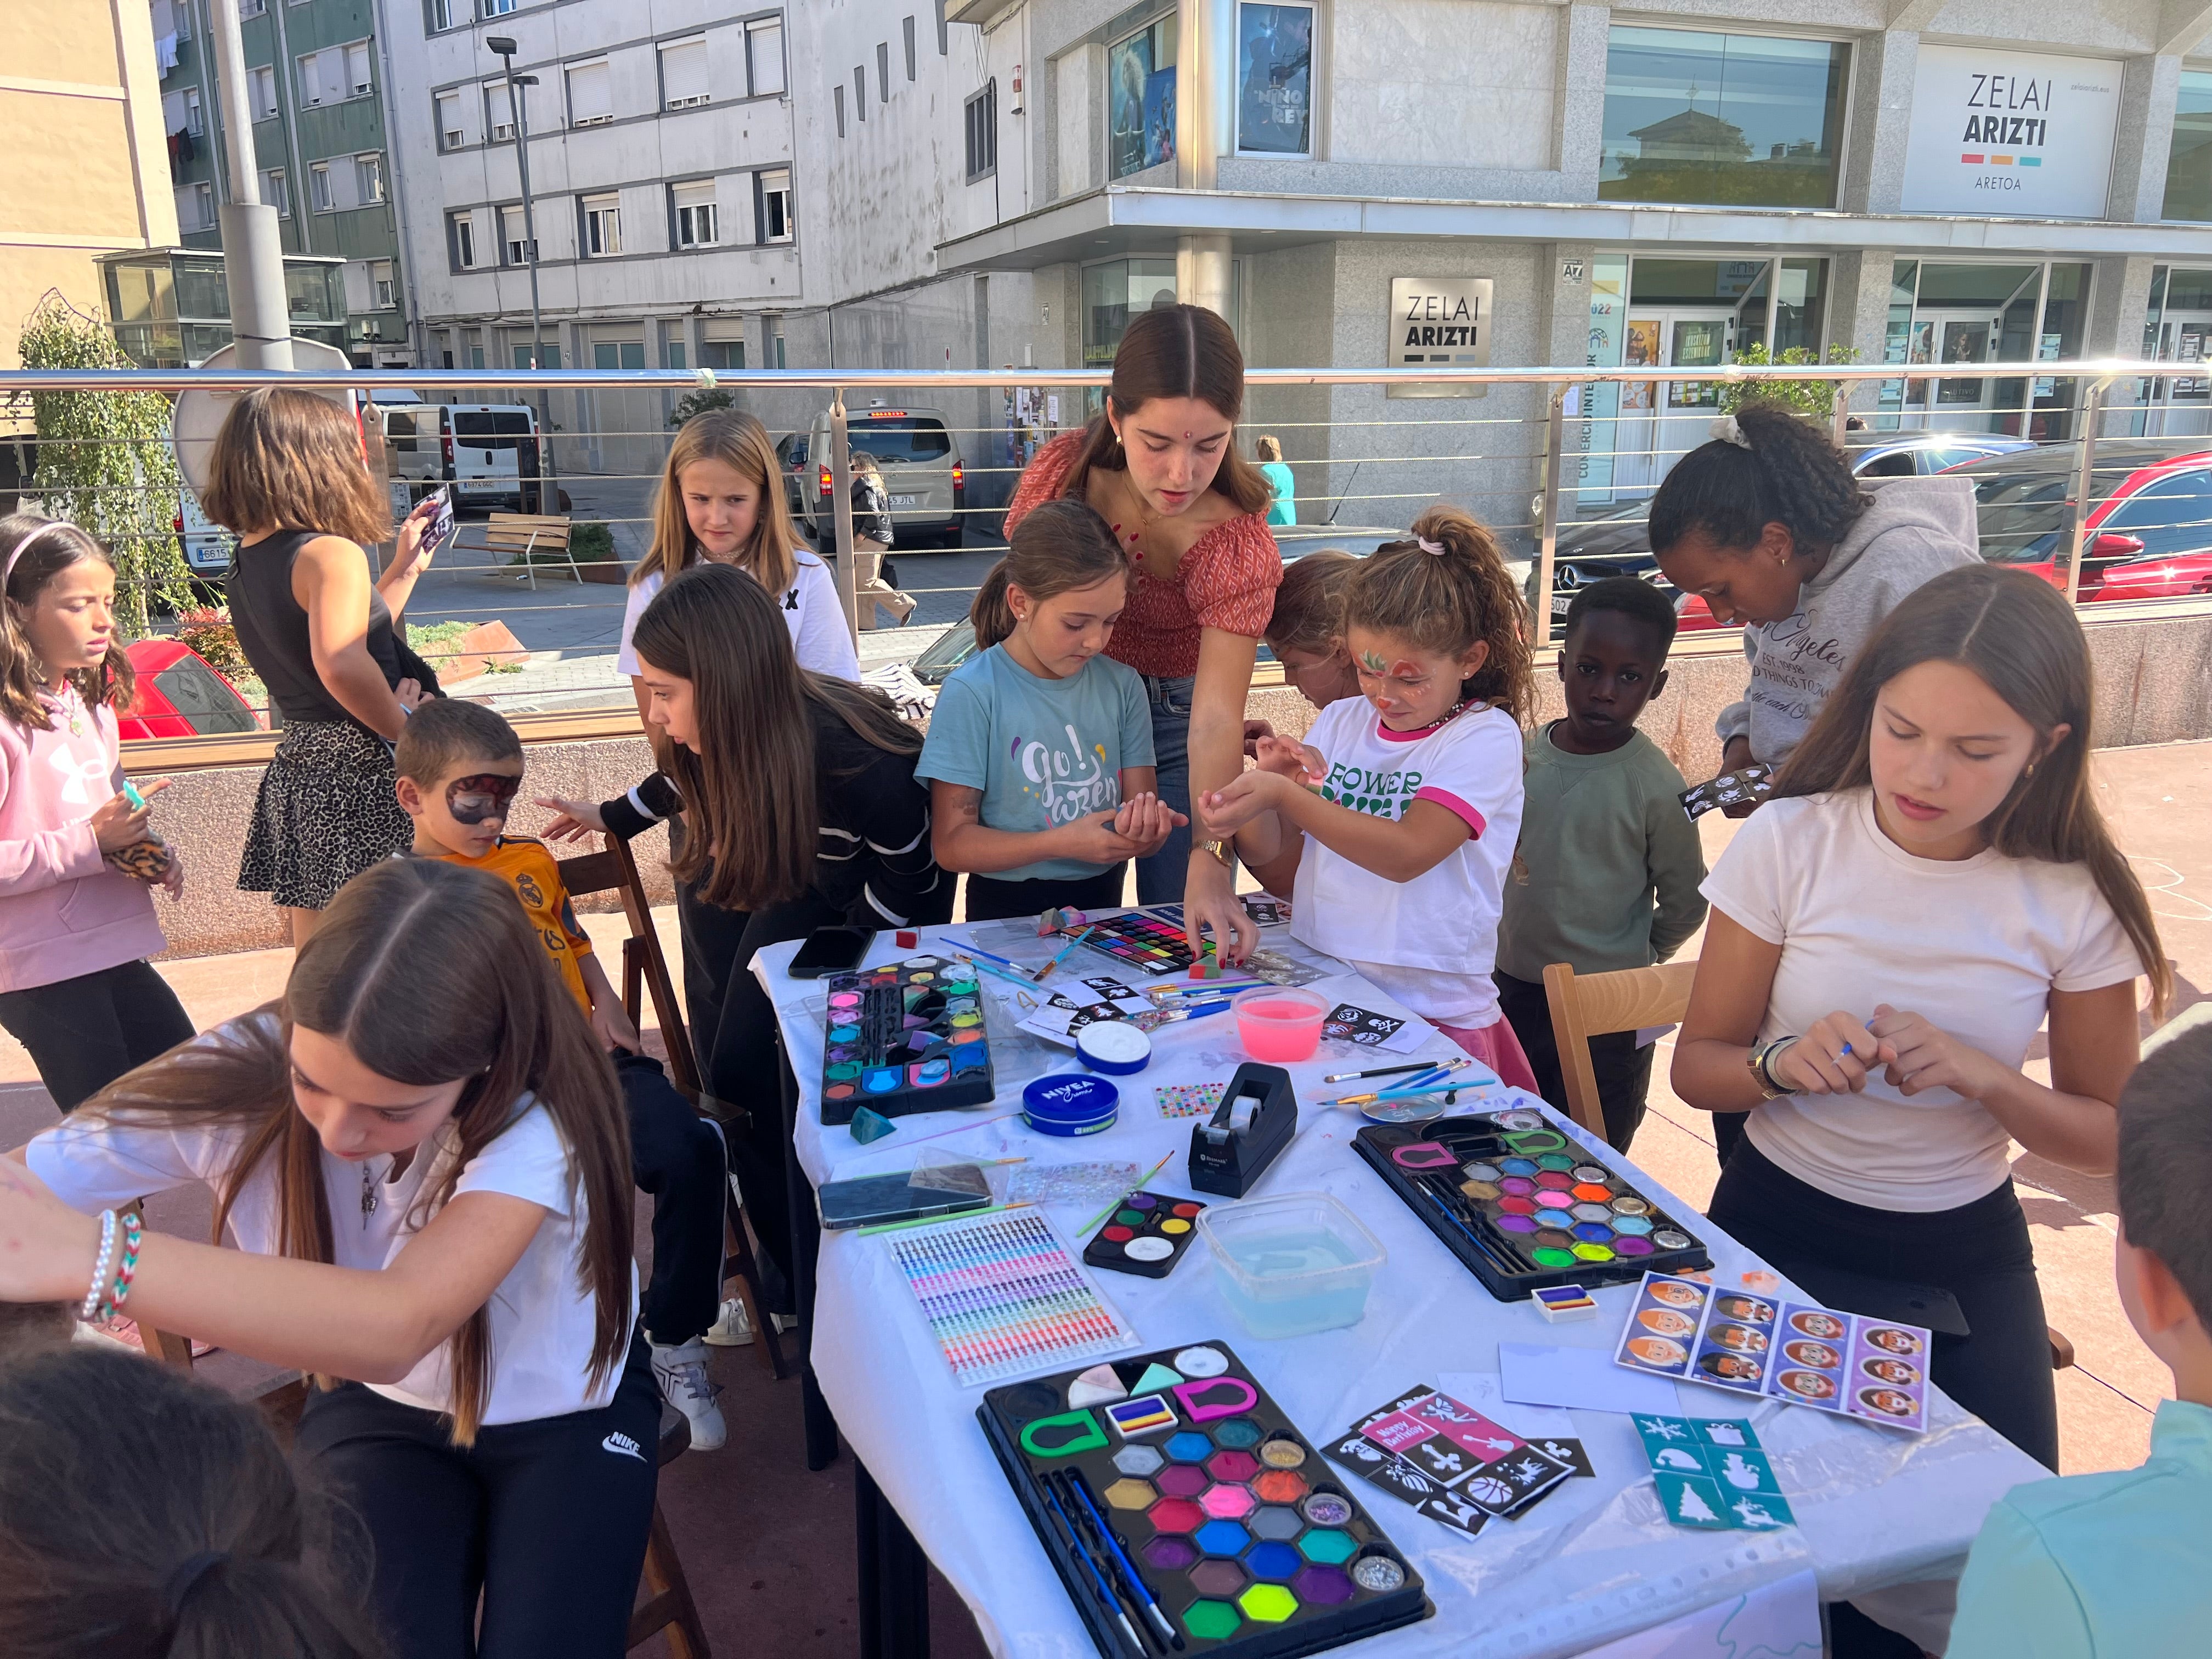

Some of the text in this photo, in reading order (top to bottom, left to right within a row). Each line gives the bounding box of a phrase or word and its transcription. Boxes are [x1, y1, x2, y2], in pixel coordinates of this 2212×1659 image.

[1967, 74, 2051, 111] ZELAI
[2070, 82, 2110, 93] zelaiarizti.eus
[1962, 115, 2046, 146] ARIZTI
[1975, 176, 2021, 190] ARETOA
[1406, 296, 1479, 321] ZELAI
[1405, 326, 1477, 346] ARIZTI
[205, 549, 227, 558] 6615
[1762, 668, 1798, 688] THINGS
[1041, 1080, 1095, 1099] NIVEA
[1063, 1088, 1093, 1103] Creme
[610, 1431, 640, 1453] NIKE
